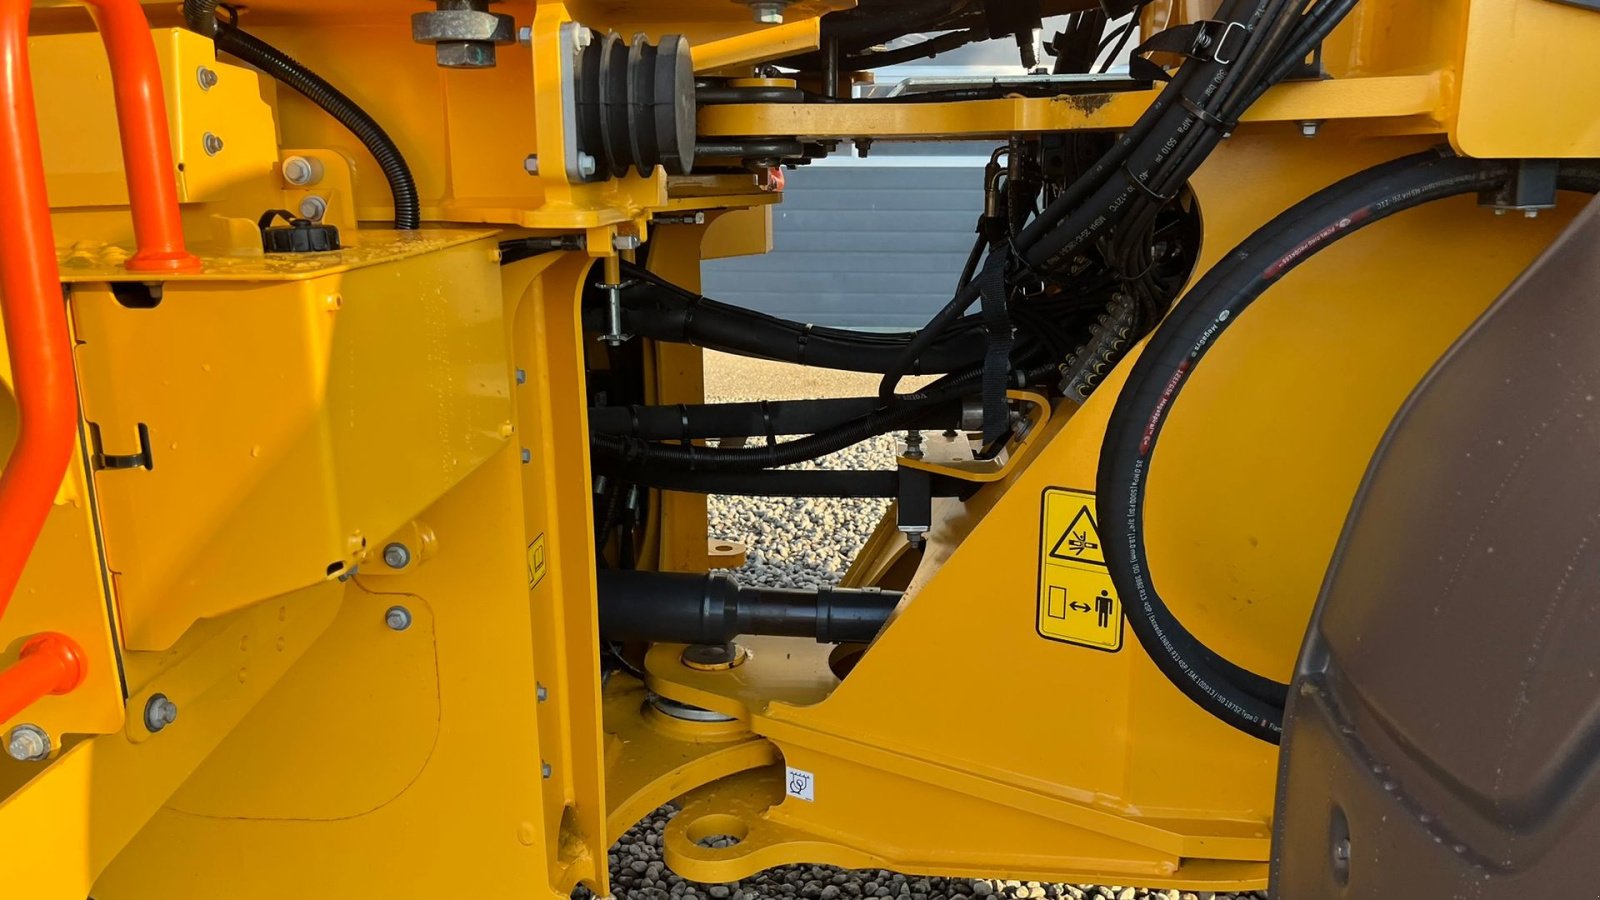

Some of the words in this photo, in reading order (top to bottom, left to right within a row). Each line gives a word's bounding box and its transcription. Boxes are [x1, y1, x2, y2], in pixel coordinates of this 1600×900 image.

[1202, 82, 1218, 98] bar
[1175, 115, 1193, 135] MPa
[1159, 135, 1178, 156] 5510
